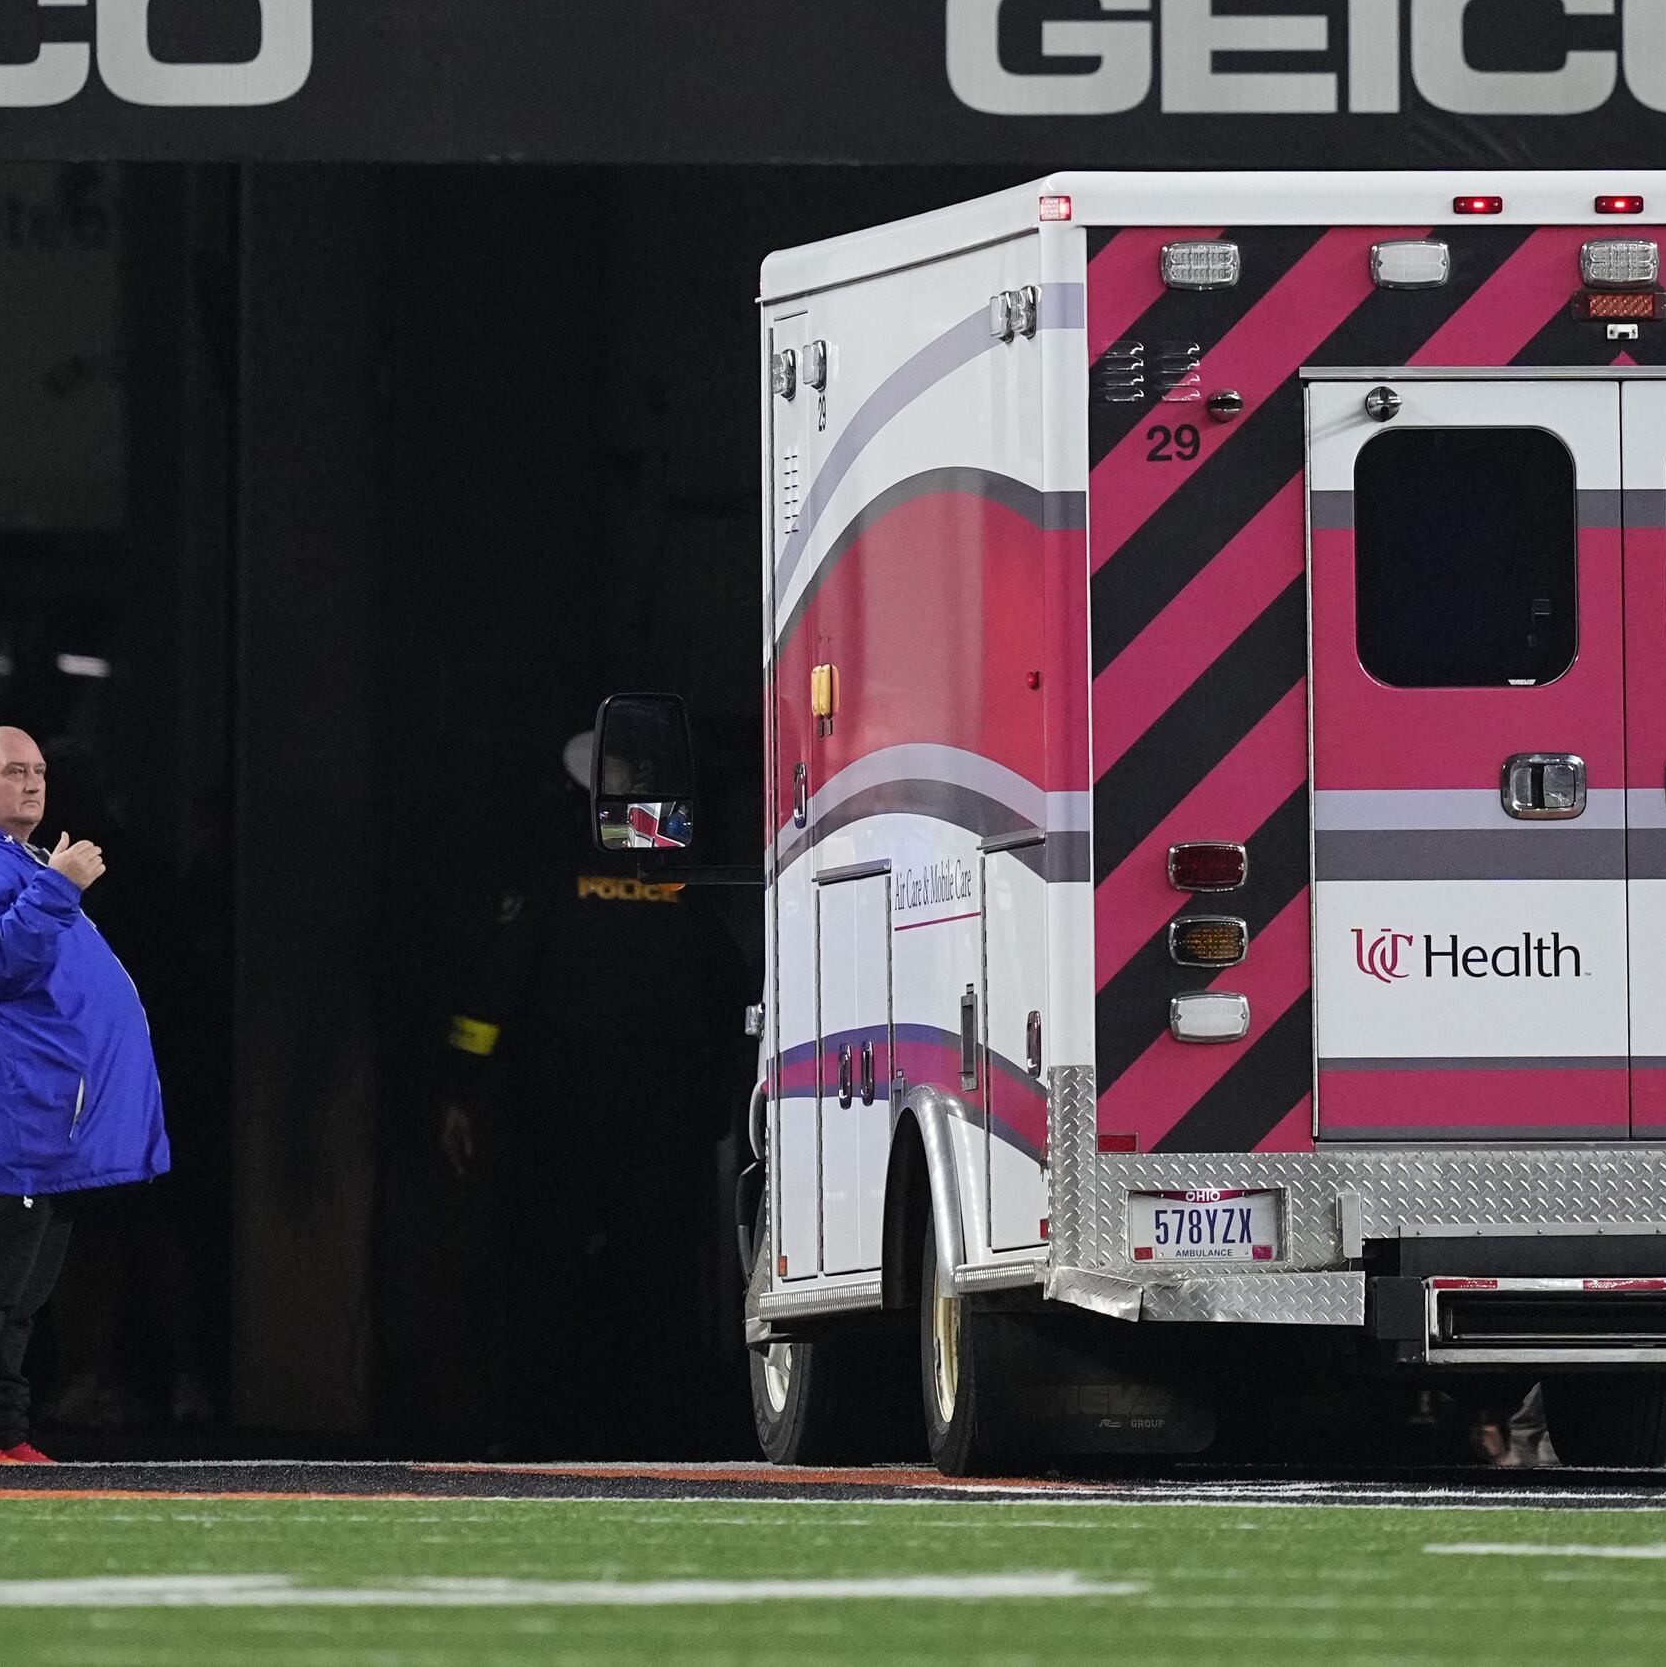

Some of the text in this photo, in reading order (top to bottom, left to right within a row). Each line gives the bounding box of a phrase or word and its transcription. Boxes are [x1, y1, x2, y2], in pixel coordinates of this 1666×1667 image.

[1145, 423, 1201, 463] 29
[576, 876, 681, 905] POLICE
[894, 858, 972, 911] Air Care & Mobile Care
[1423, 931, 1581, 977] Health
[1185, 1190, 1221, 1202] OHIO
[1154, 1207, 1253, 1245] 578YZX
[1174, 1247, 1234, 1258] AMBULANCE
[1130, 1418, 1166, 1429] GROUP
